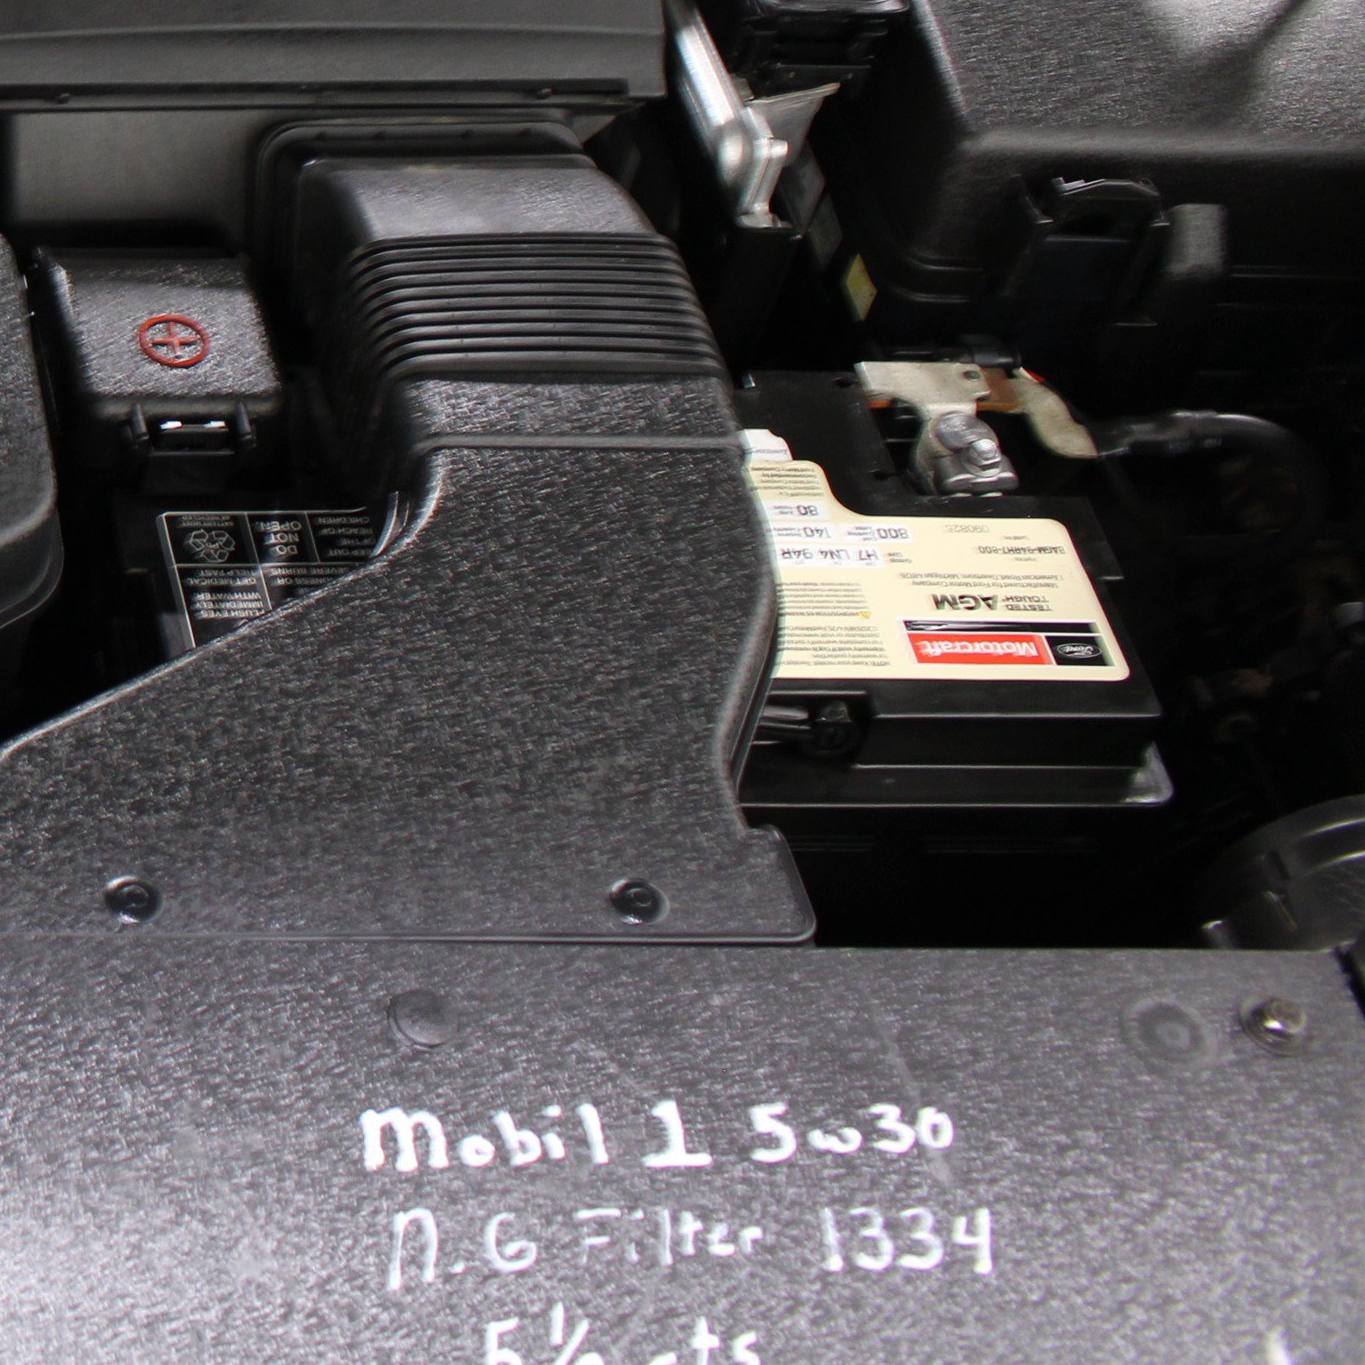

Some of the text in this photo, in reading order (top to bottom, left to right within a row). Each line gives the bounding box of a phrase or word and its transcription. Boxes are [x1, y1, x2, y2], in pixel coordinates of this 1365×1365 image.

[796, 505, 819, 516] 80
[268, 531, 300, 544] NOT
[802, 527, 830, 538] 140
[877, 528, 910, 539] 800
[275, 544, 298, 556] DO
[780, 548, 814, 560] 94R
[818, 548, 850, 560] LN4
[857, 548, 878, 561] H7
[199, 569, 255, 577] HELP FAST
[271, 567, 307, 575] BURNS
[186, 577, 257, 586] GET MEDICAL
[277, 577, 293, 585] OR
[195, 591, 262, 601] WITH WATER
[195, 600, 264, 609] IMMEDIATELY
[930, 593, 999, 611] AGM
[1004, 603, 1053, 612] TESTED
[200, 609, 229, 618] EYES
[916, 639, 1038, 658] Motorcraft
[642, 1100, 713, 1168] 1
[821, 1207, 994, 1275] 1334
